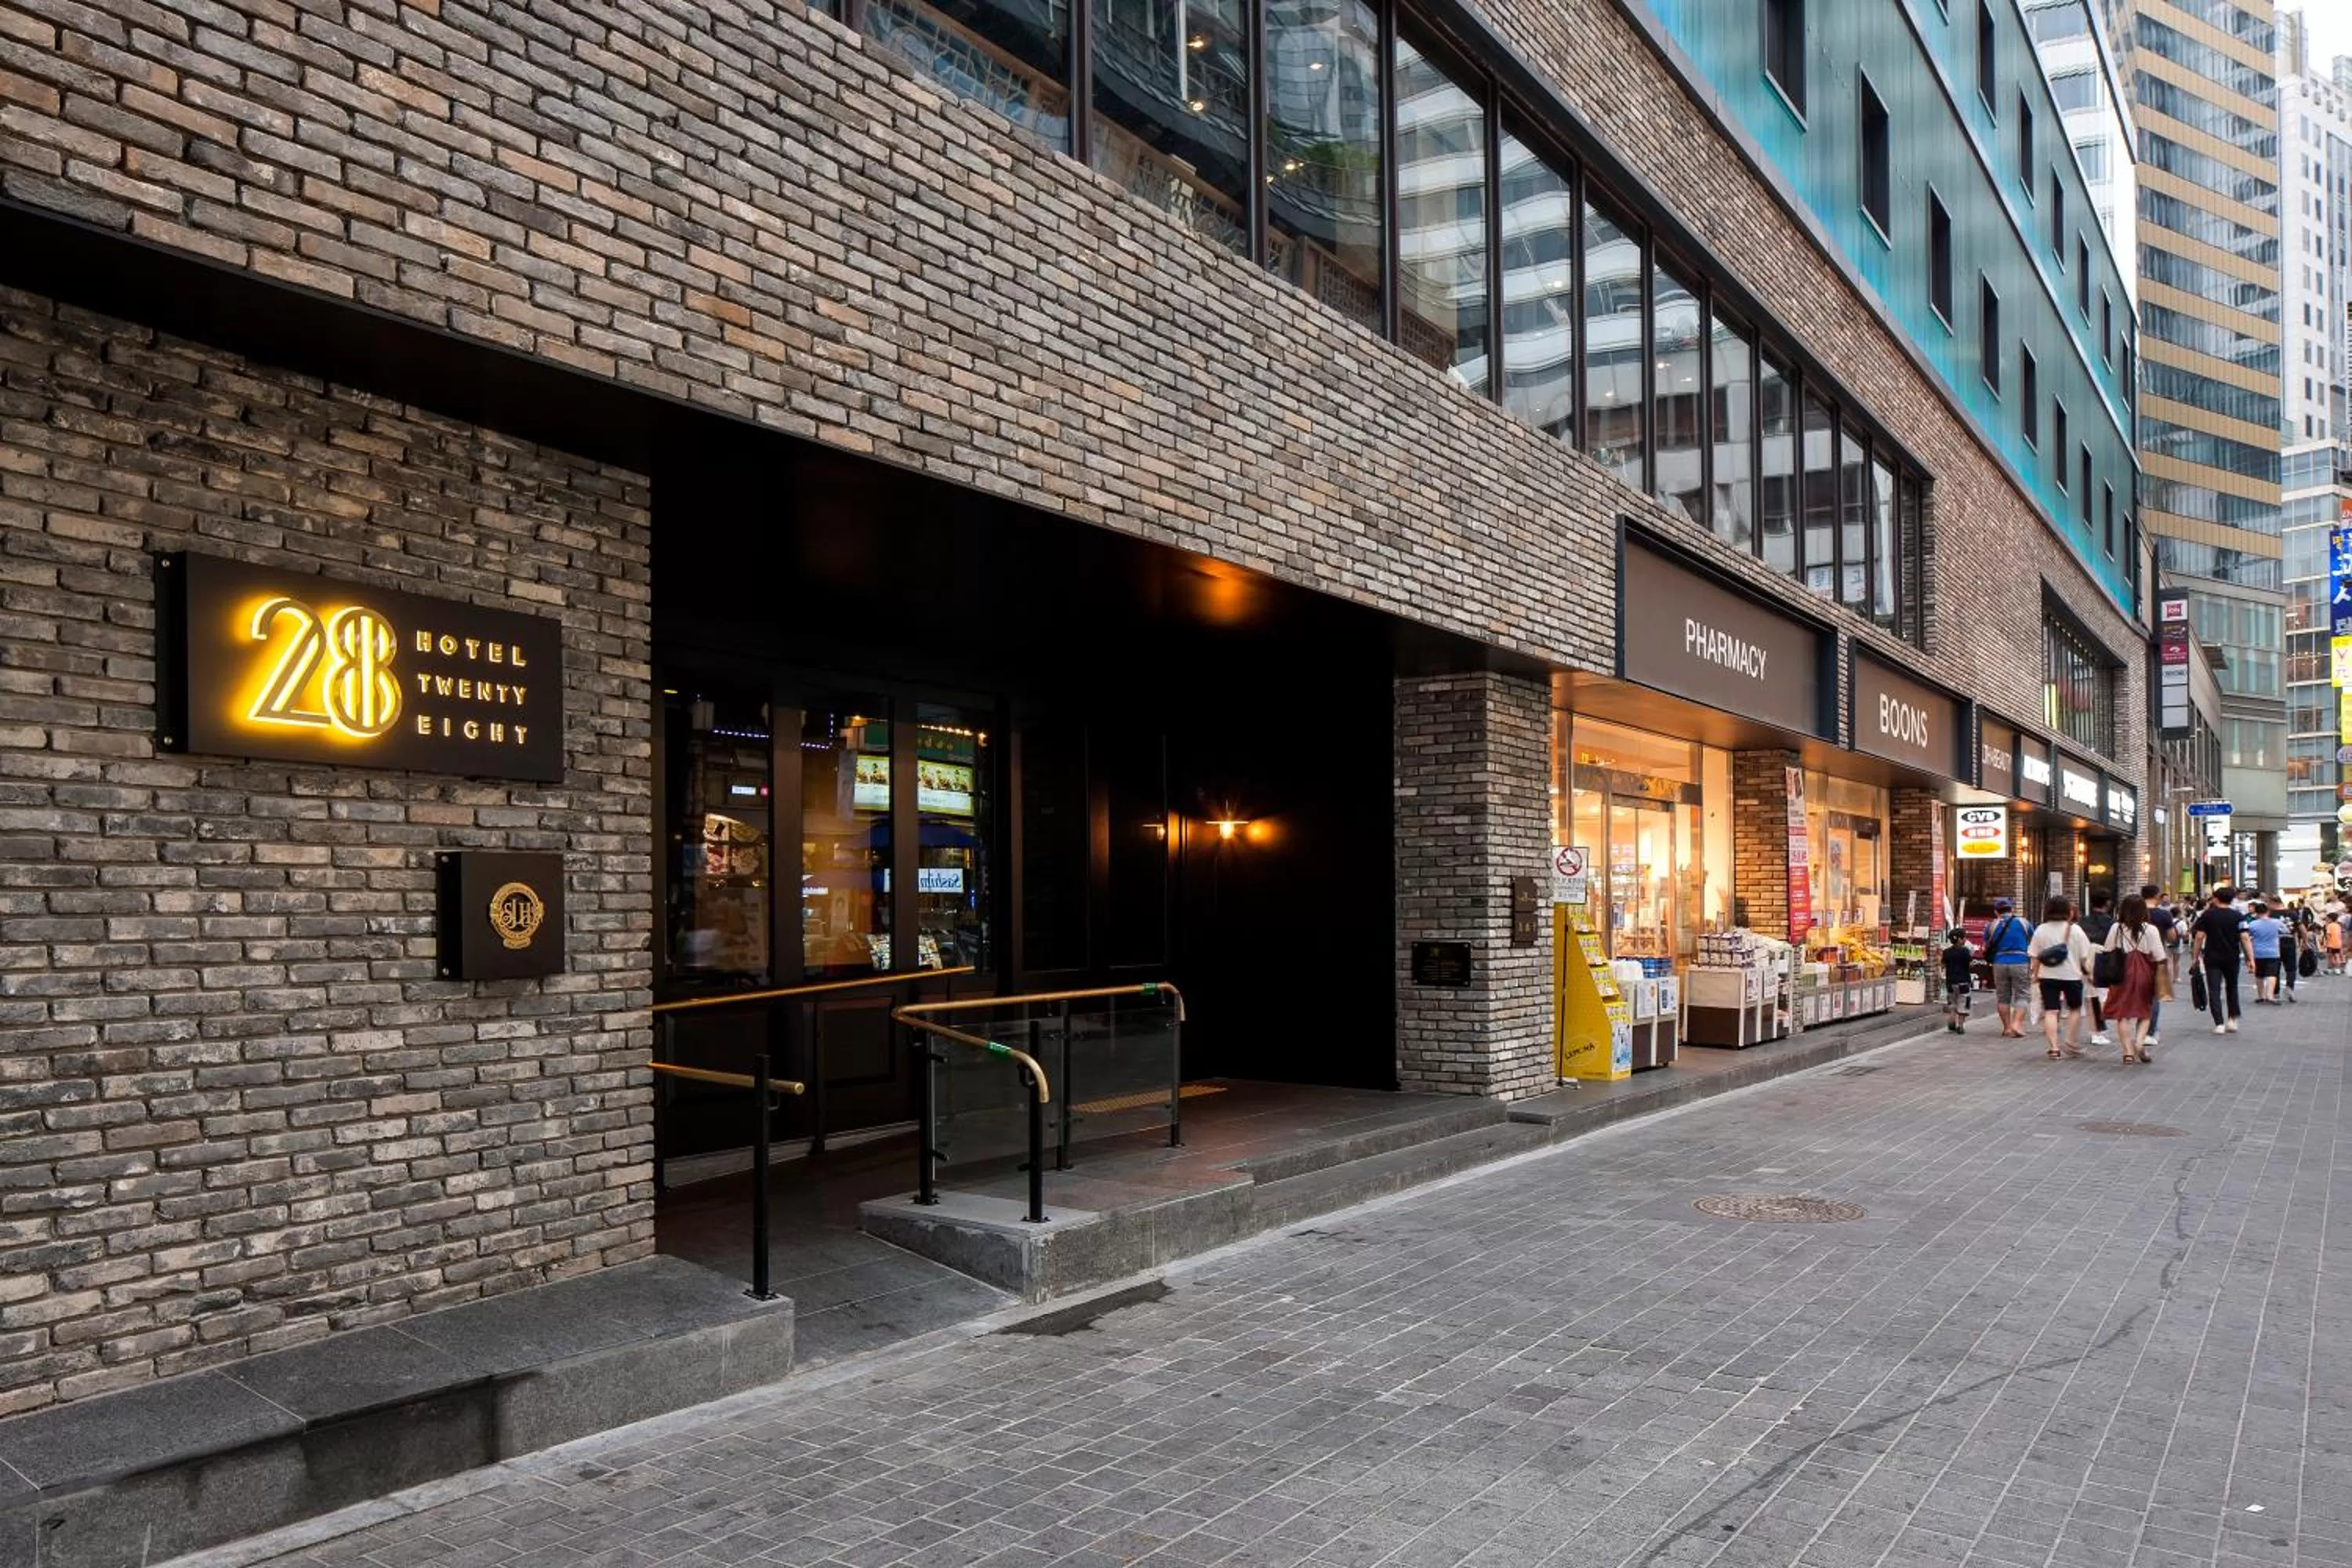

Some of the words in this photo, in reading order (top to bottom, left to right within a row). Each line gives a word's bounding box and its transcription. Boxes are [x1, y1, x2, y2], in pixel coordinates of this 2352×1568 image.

[249, 597, 403, 738] 28
[416, 630, 528, 666] HOTEL
[1686, 617, 1767, 681] PHARMACY
[418, 673, 528, 705] TWENTY
[418, 714, 528, 744] EIGHT
[1879, 692, 1929, 748] BOONS
